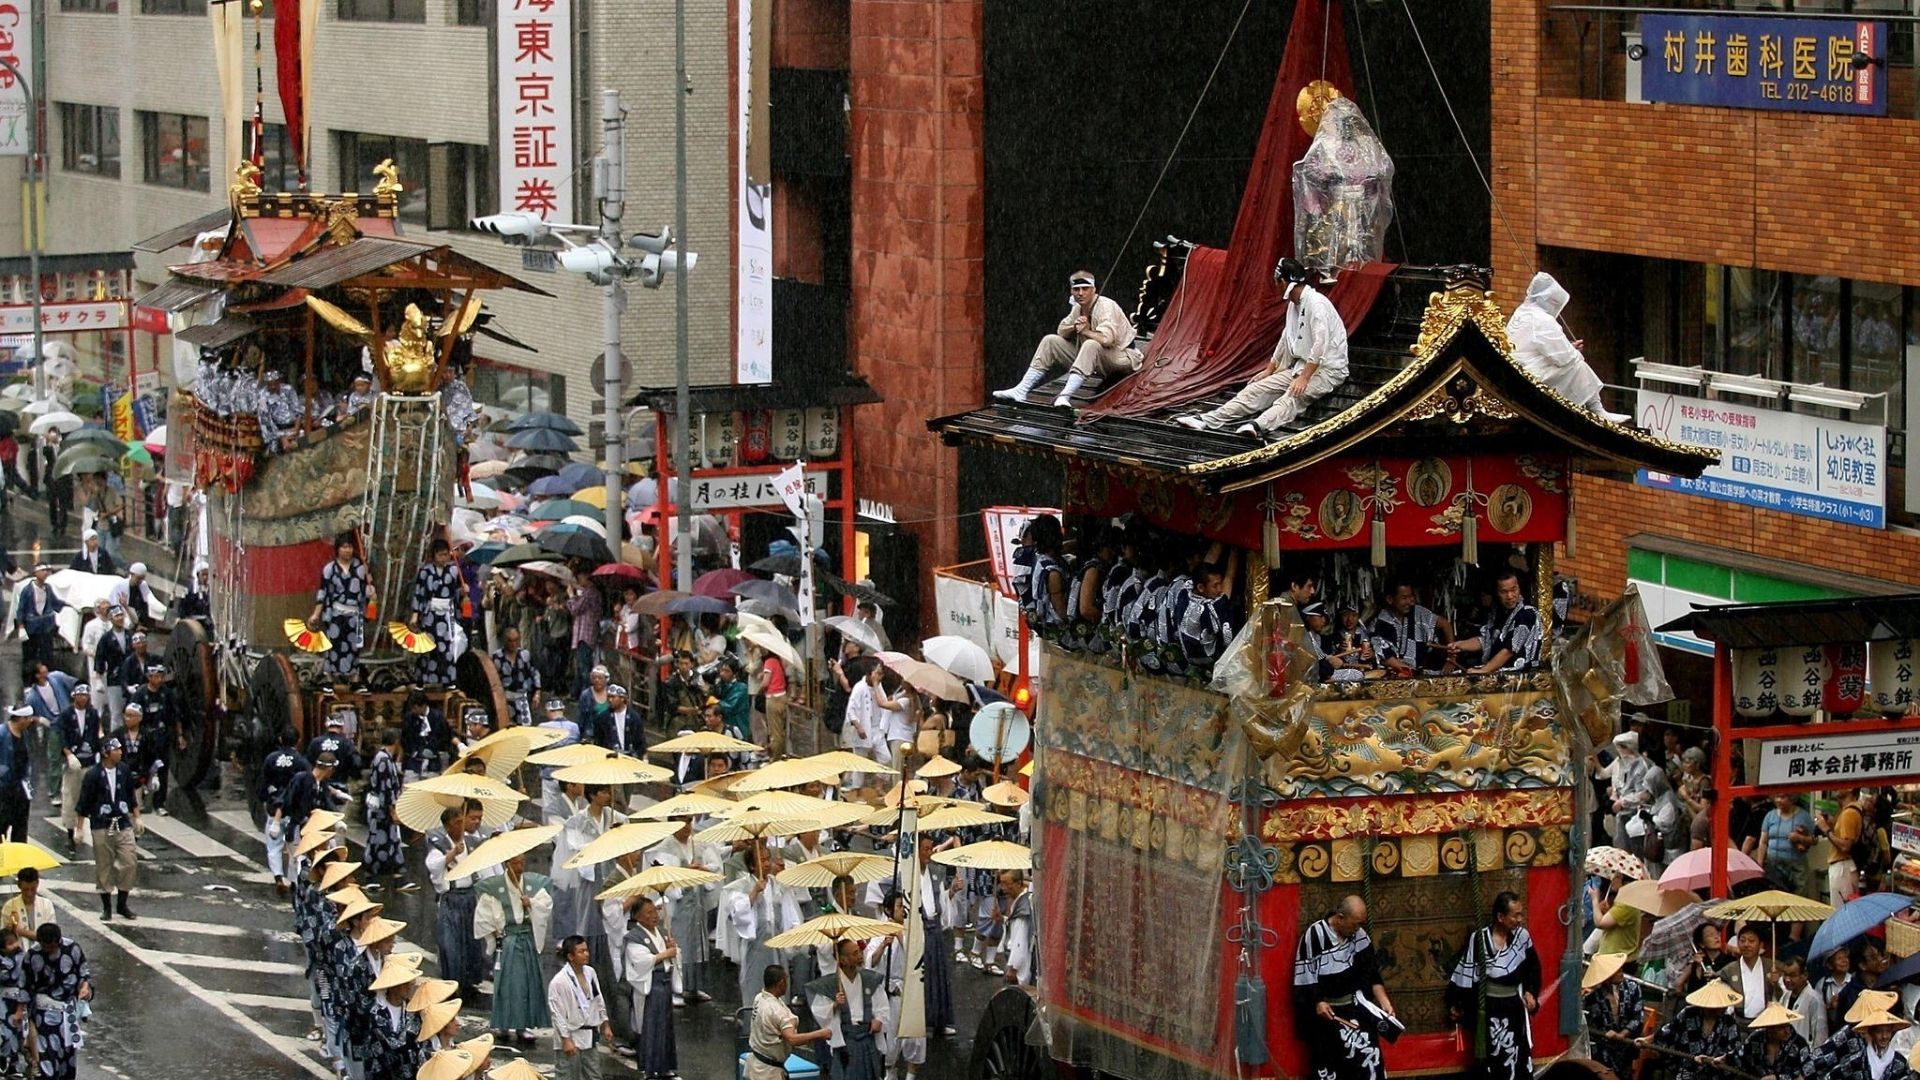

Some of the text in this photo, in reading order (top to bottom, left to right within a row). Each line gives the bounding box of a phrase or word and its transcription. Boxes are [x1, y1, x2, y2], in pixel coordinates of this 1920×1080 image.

[1664, 30, 1853, 81] 村井歯科医院
[1859, 25, 1869, 101] AE設置
[1760, 82, 1853, 103] TEL 212-4618
[513, 0, 557, 221] 東京証券
[40, 310, 107, 325] キザクラ
[1826, 430, 1876, 458] しょうがく社
[1826, 456, 1876, 486] 幼児教室
[859, 498, 894, 521] WAON
[1788, 750, 1913, 778] 岡本会計事務所
